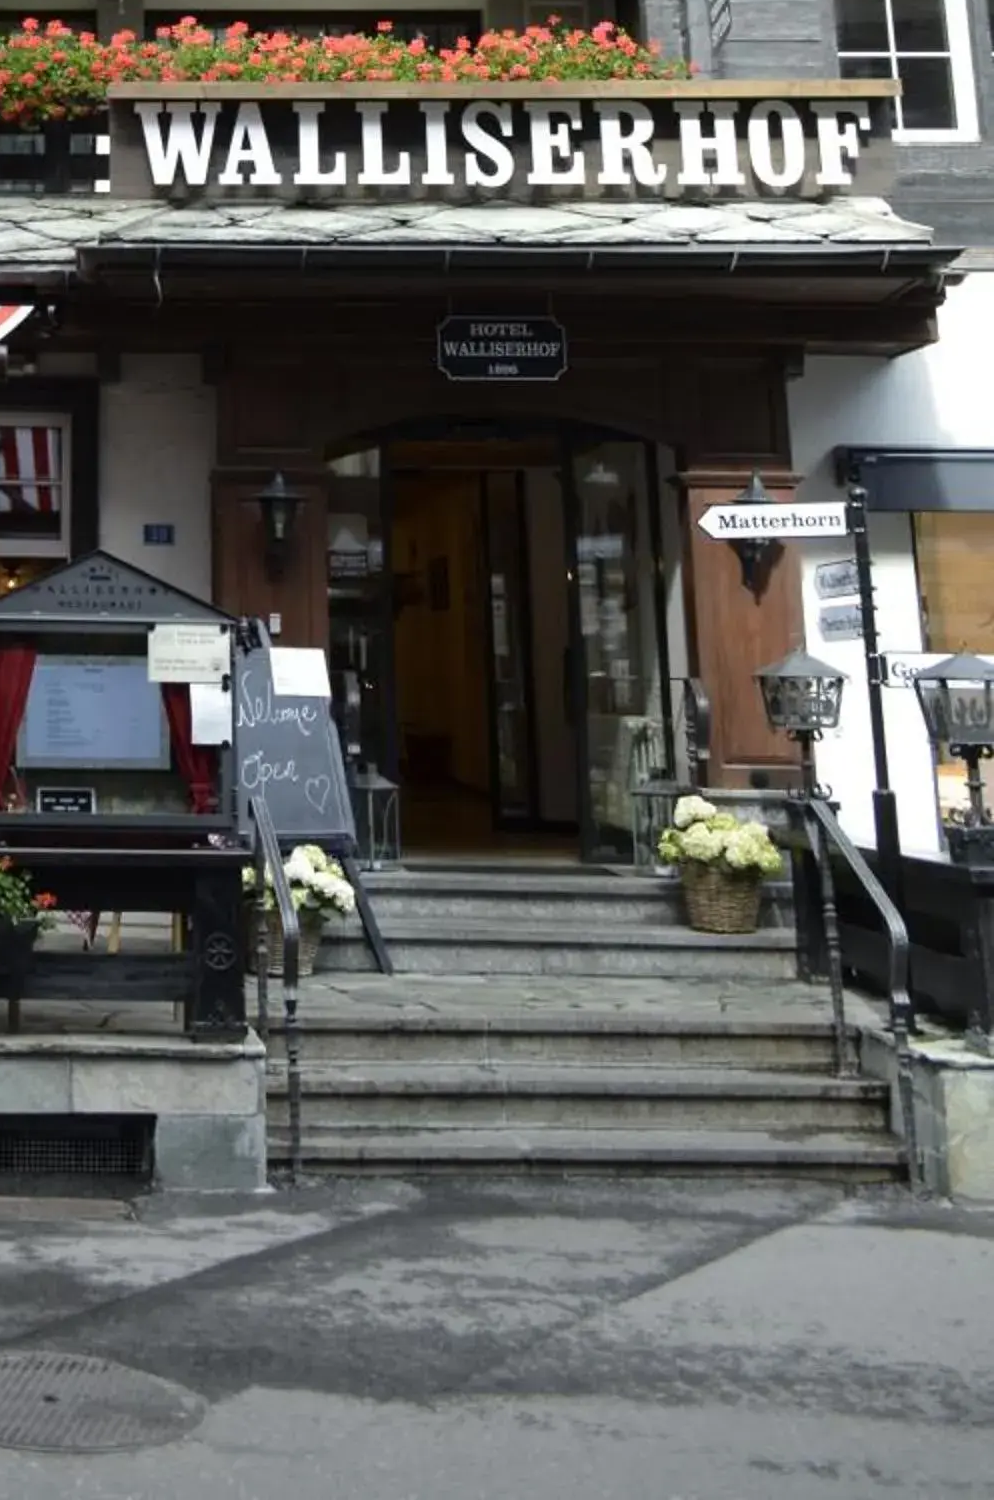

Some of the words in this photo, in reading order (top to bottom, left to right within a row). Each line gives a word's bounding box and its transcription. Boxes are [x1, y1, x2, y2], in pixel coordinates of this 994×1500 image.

[133, 100, 871, 188] WALLISERHOF
[470, 323, 534, 337] HOTEL
[444, 341, 561, 357] WALLISERHOF
[717, 513, 842, 530] Matterhorn
